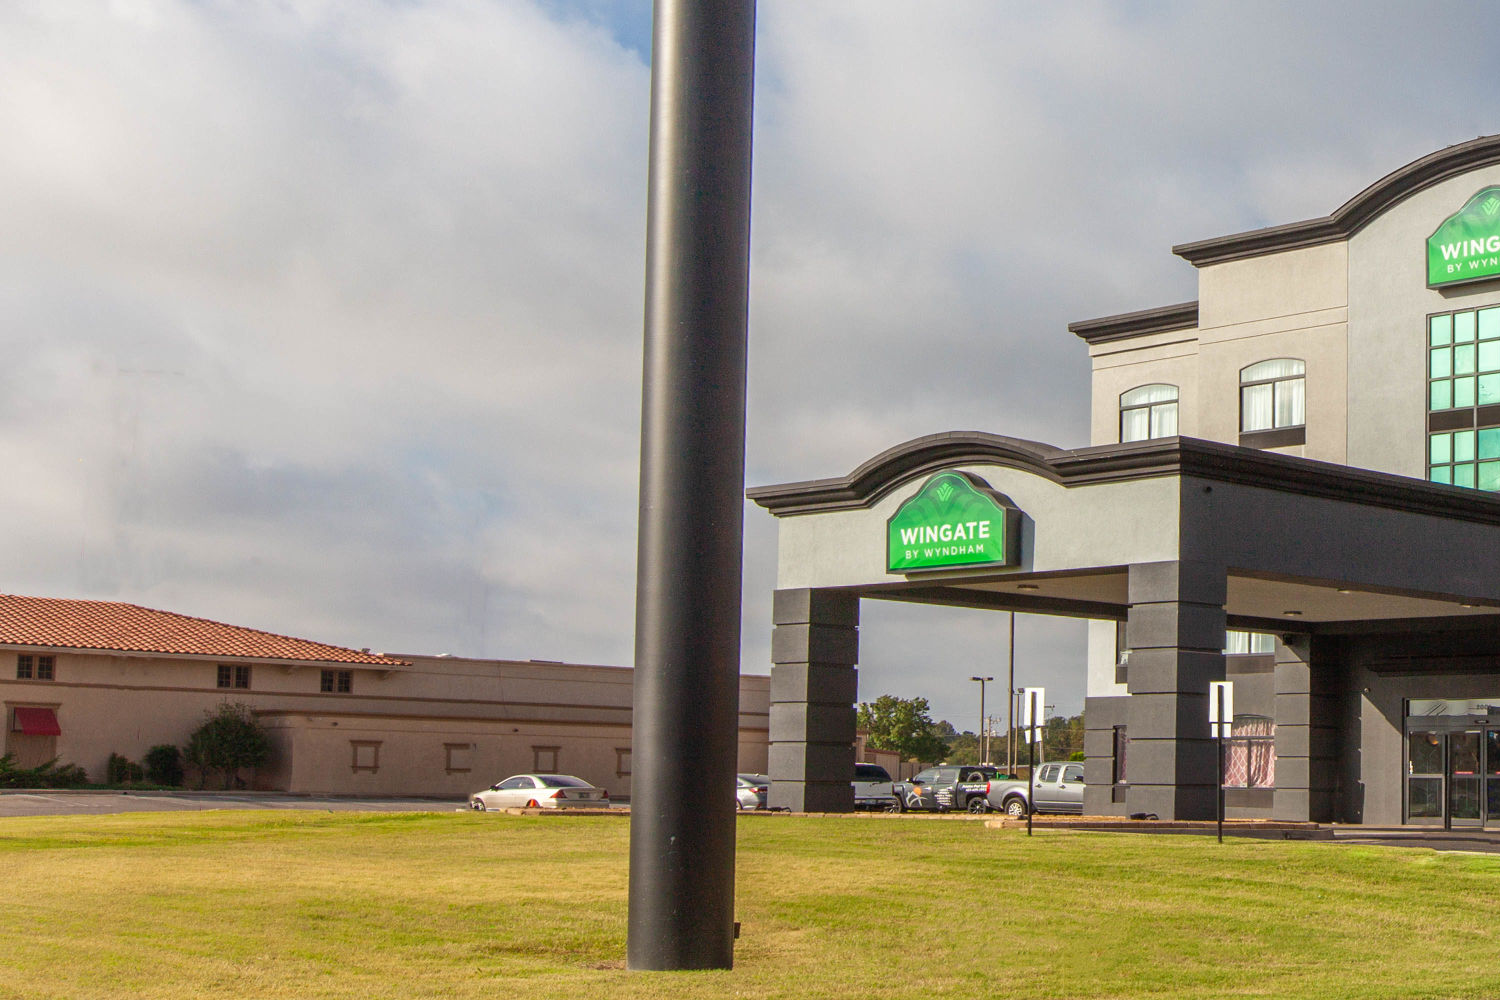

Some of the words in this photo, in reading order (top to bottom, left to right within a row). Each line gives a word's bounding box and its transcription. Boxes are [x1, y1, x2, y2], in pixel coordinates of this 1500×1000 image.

[1447, 262, 1463, 274] BY
[900, 520, 991, 546] WINGATE
[905, 550, 919, 560] BY
[924, 543, 985, 559] WYNDHAM
